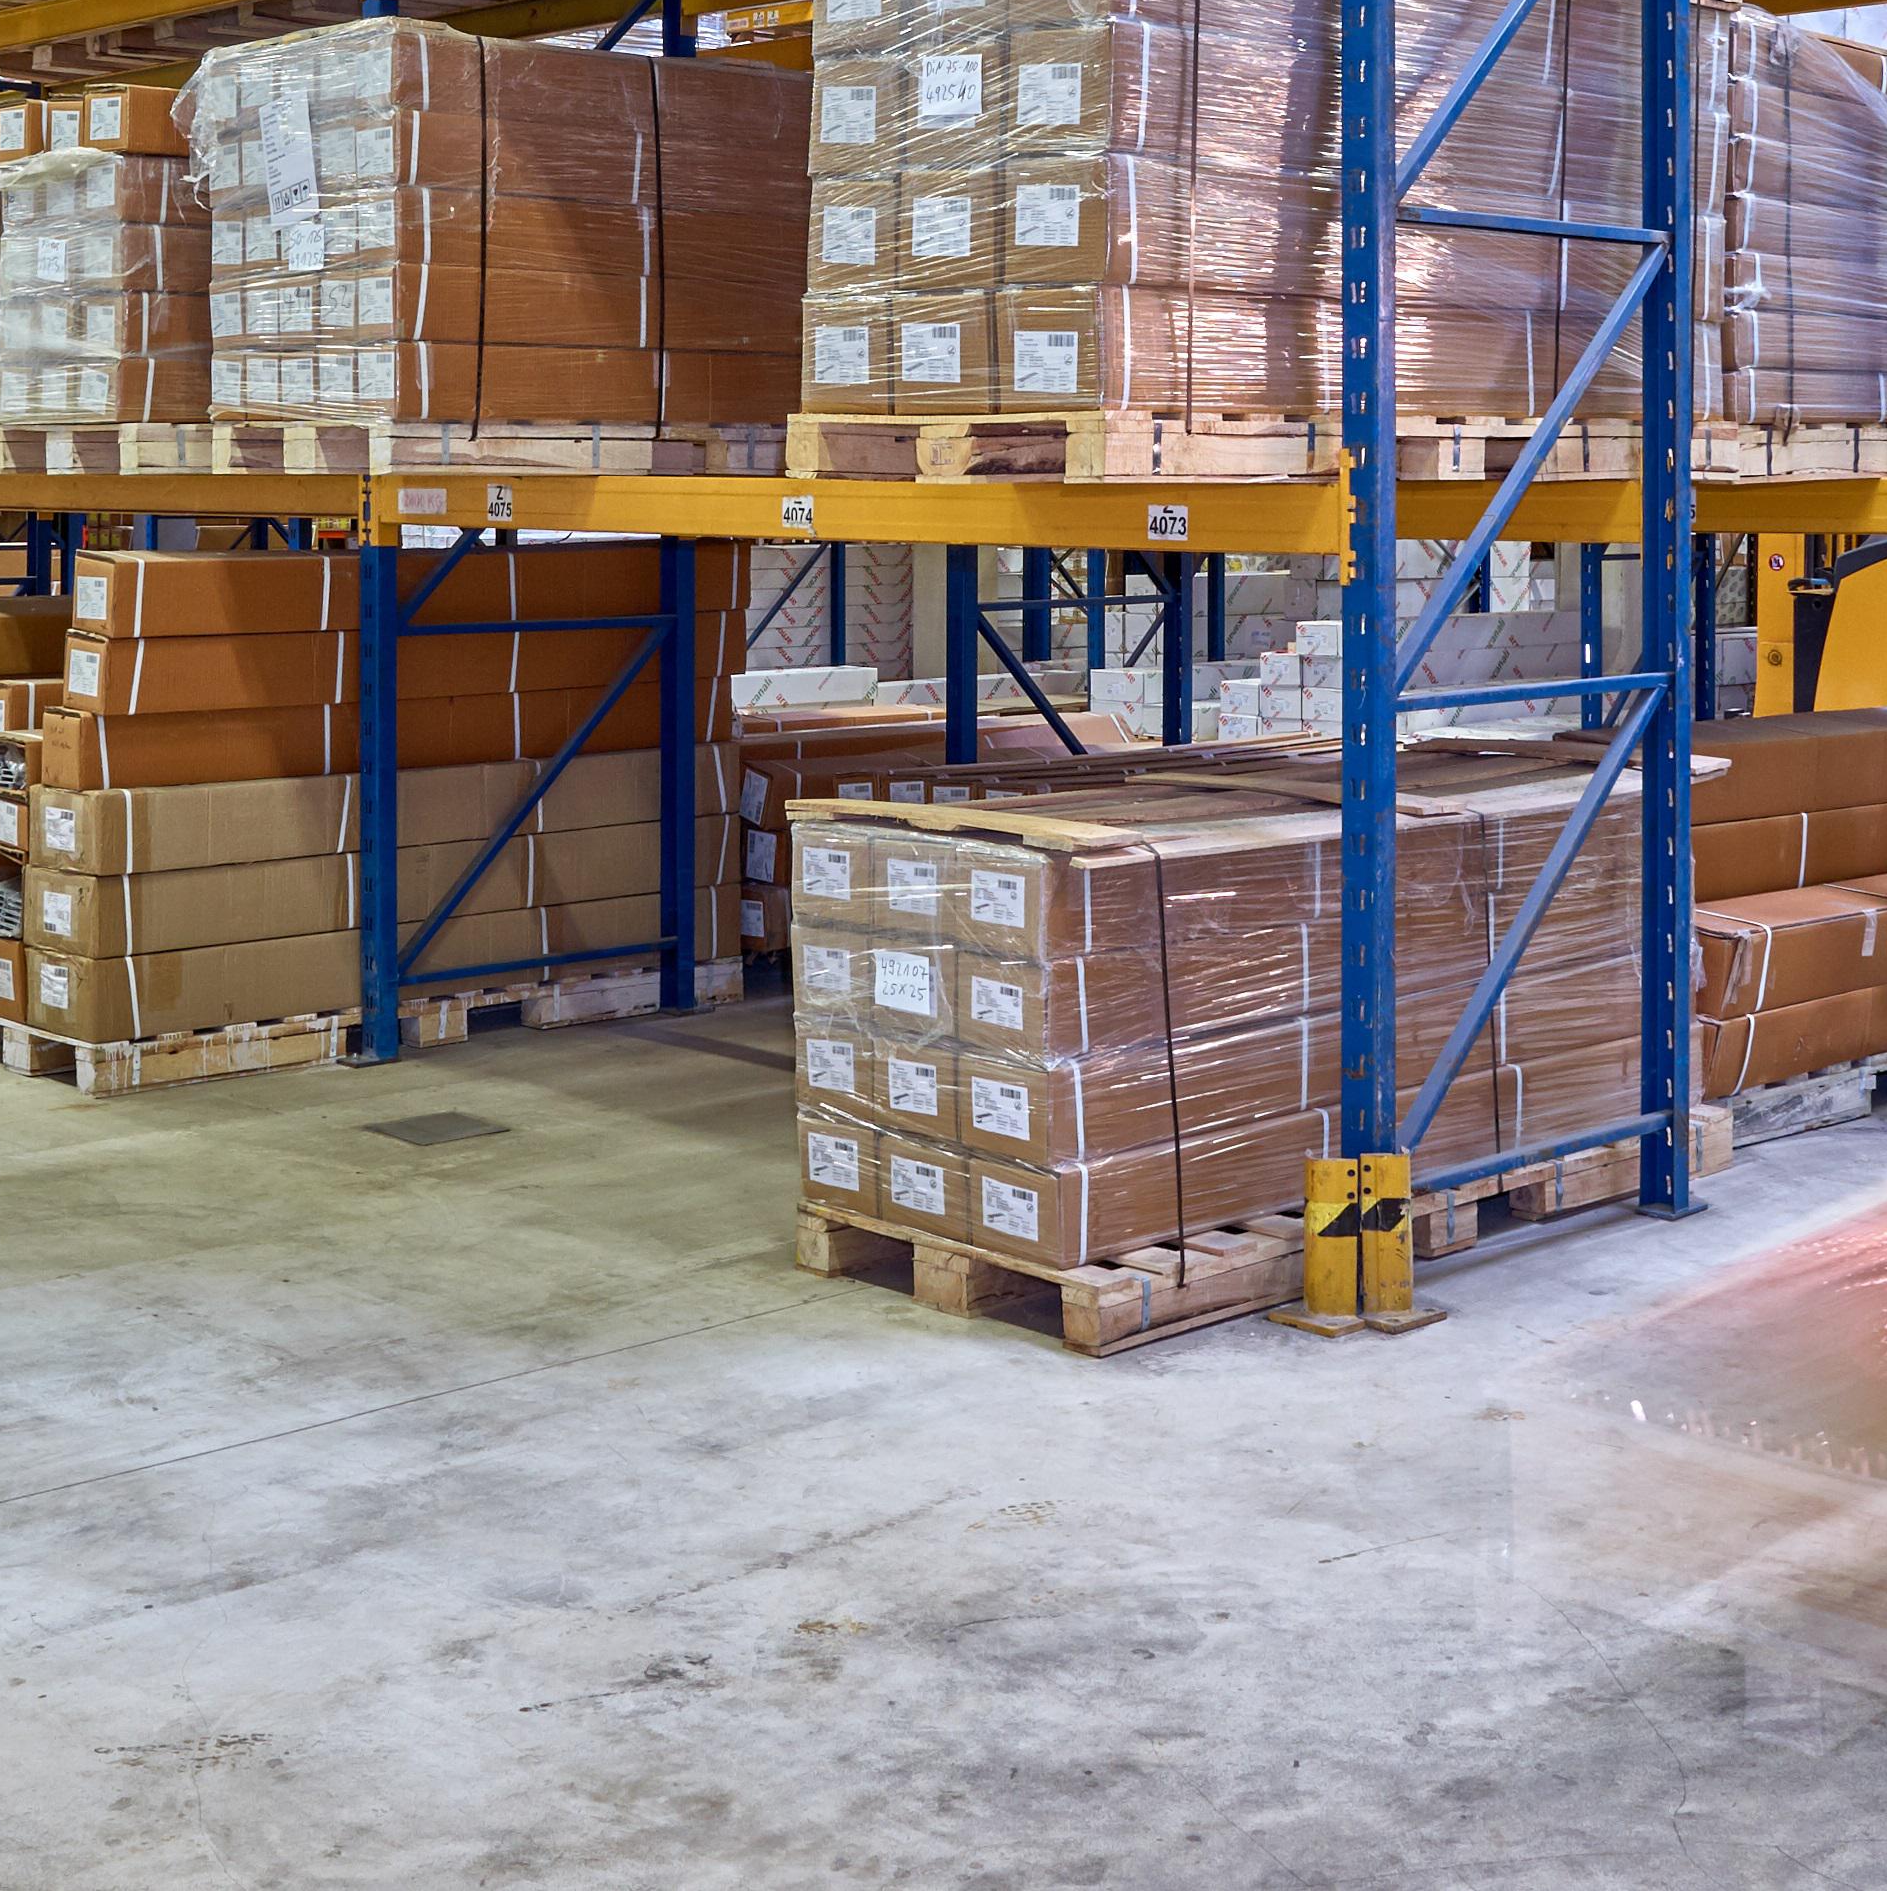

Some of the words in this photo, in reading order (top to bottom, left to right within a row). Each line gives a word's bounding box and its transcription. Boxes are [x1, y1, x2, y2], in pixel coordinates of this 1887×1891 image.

[926, 80, 977, 104] 492540
[496, 486, 504, 501] Z
[488, 502, 512, 518] 4075
[783, 506, 813, 525] 4074
[1149, 516, 1187, 536] 4073
[881, 957, 929, 981] 492107
